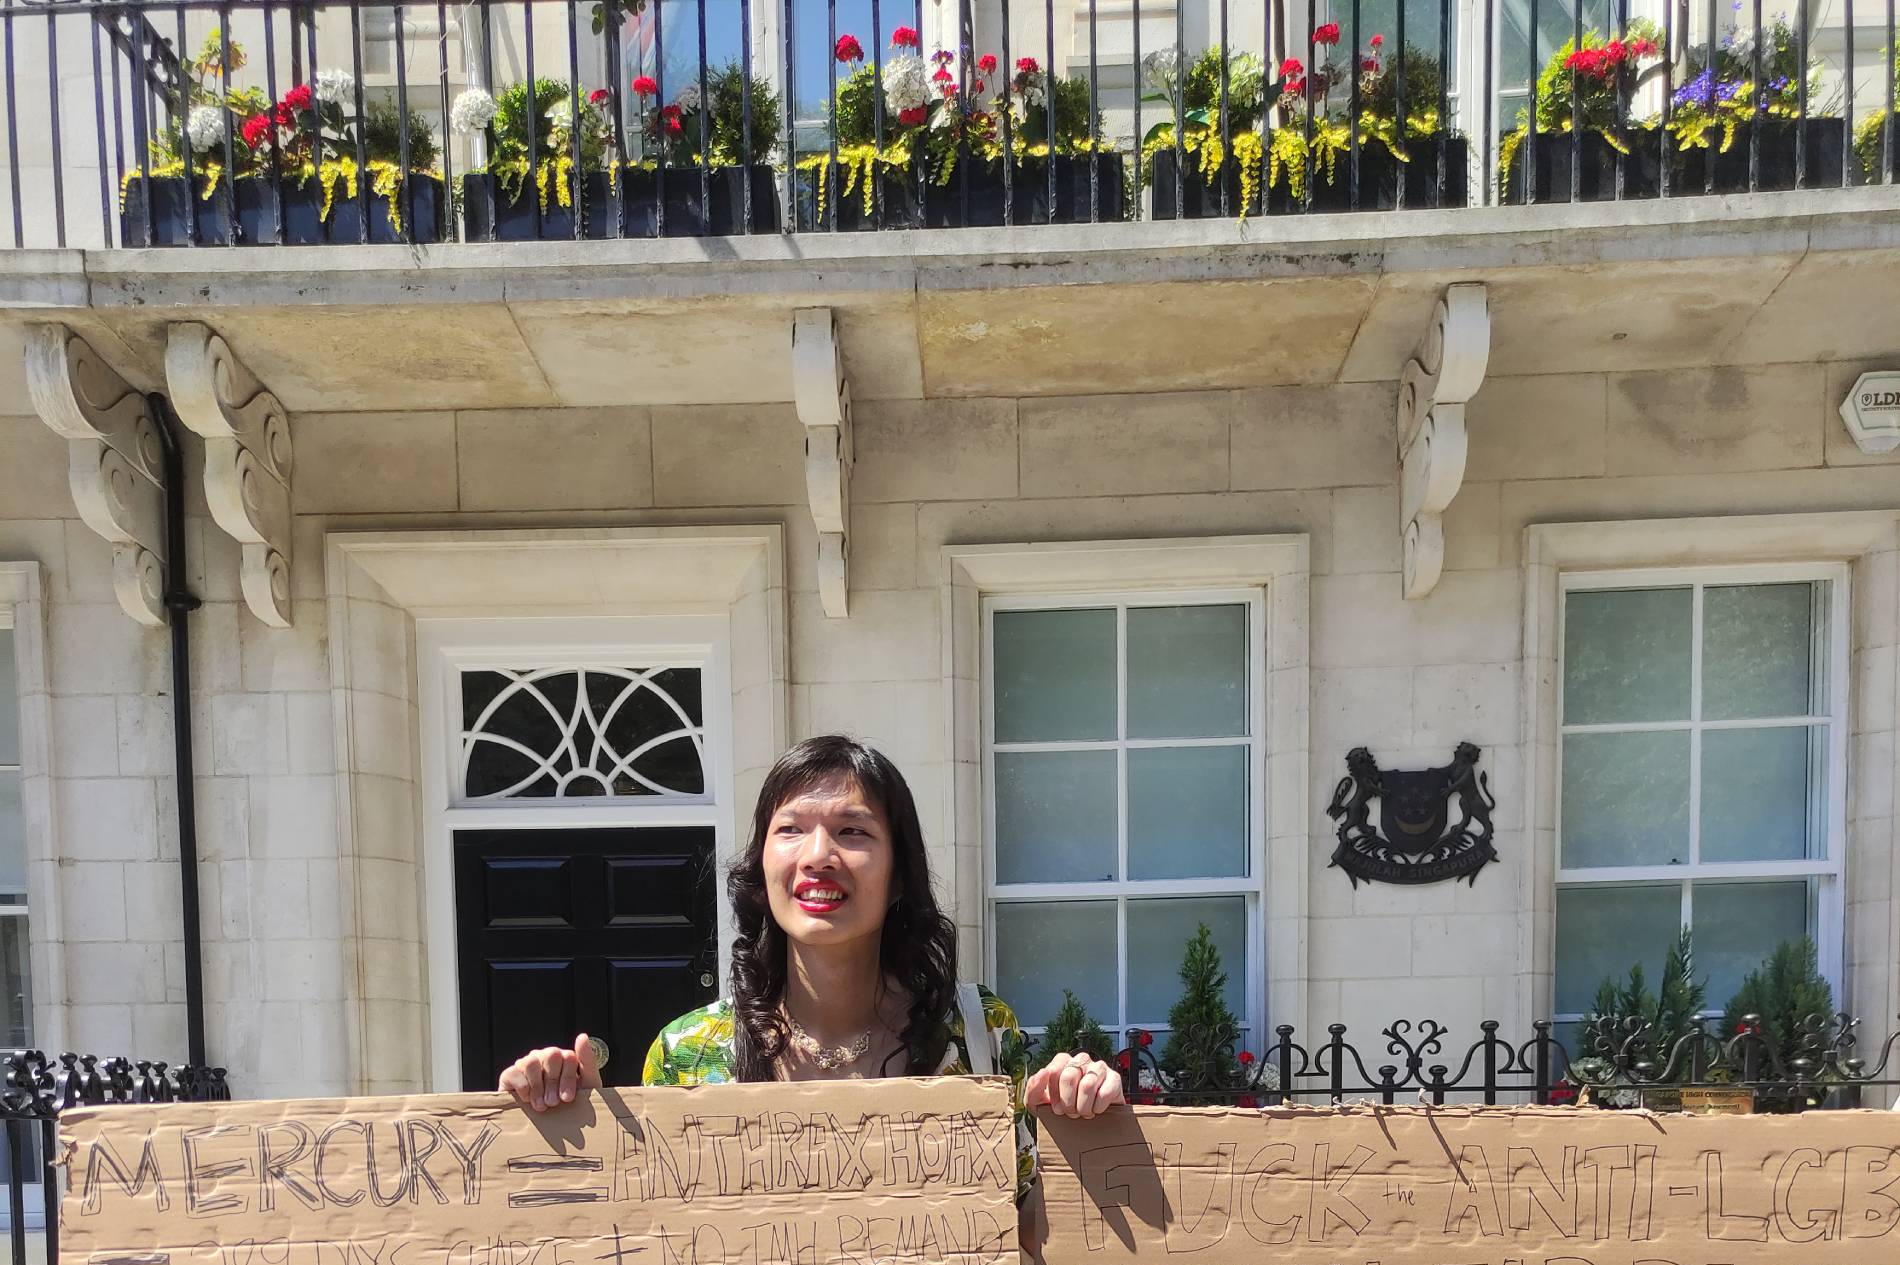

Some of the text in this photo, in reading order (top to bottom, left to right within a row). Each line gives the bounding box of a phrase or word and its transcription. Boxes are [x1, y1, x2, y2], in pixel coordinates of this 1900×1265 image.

[1344, 851, 1401, 878] AJULAH
[81, 1119, 502, 1218] MERCURY
[613, 1111, 876, 1204] ANTHRAX
[880, 1110, 1013, 1190] HOAX
[1078, 1142, 1378, 1254] FUCK
[1382, 1180, 1416, 1206] the
